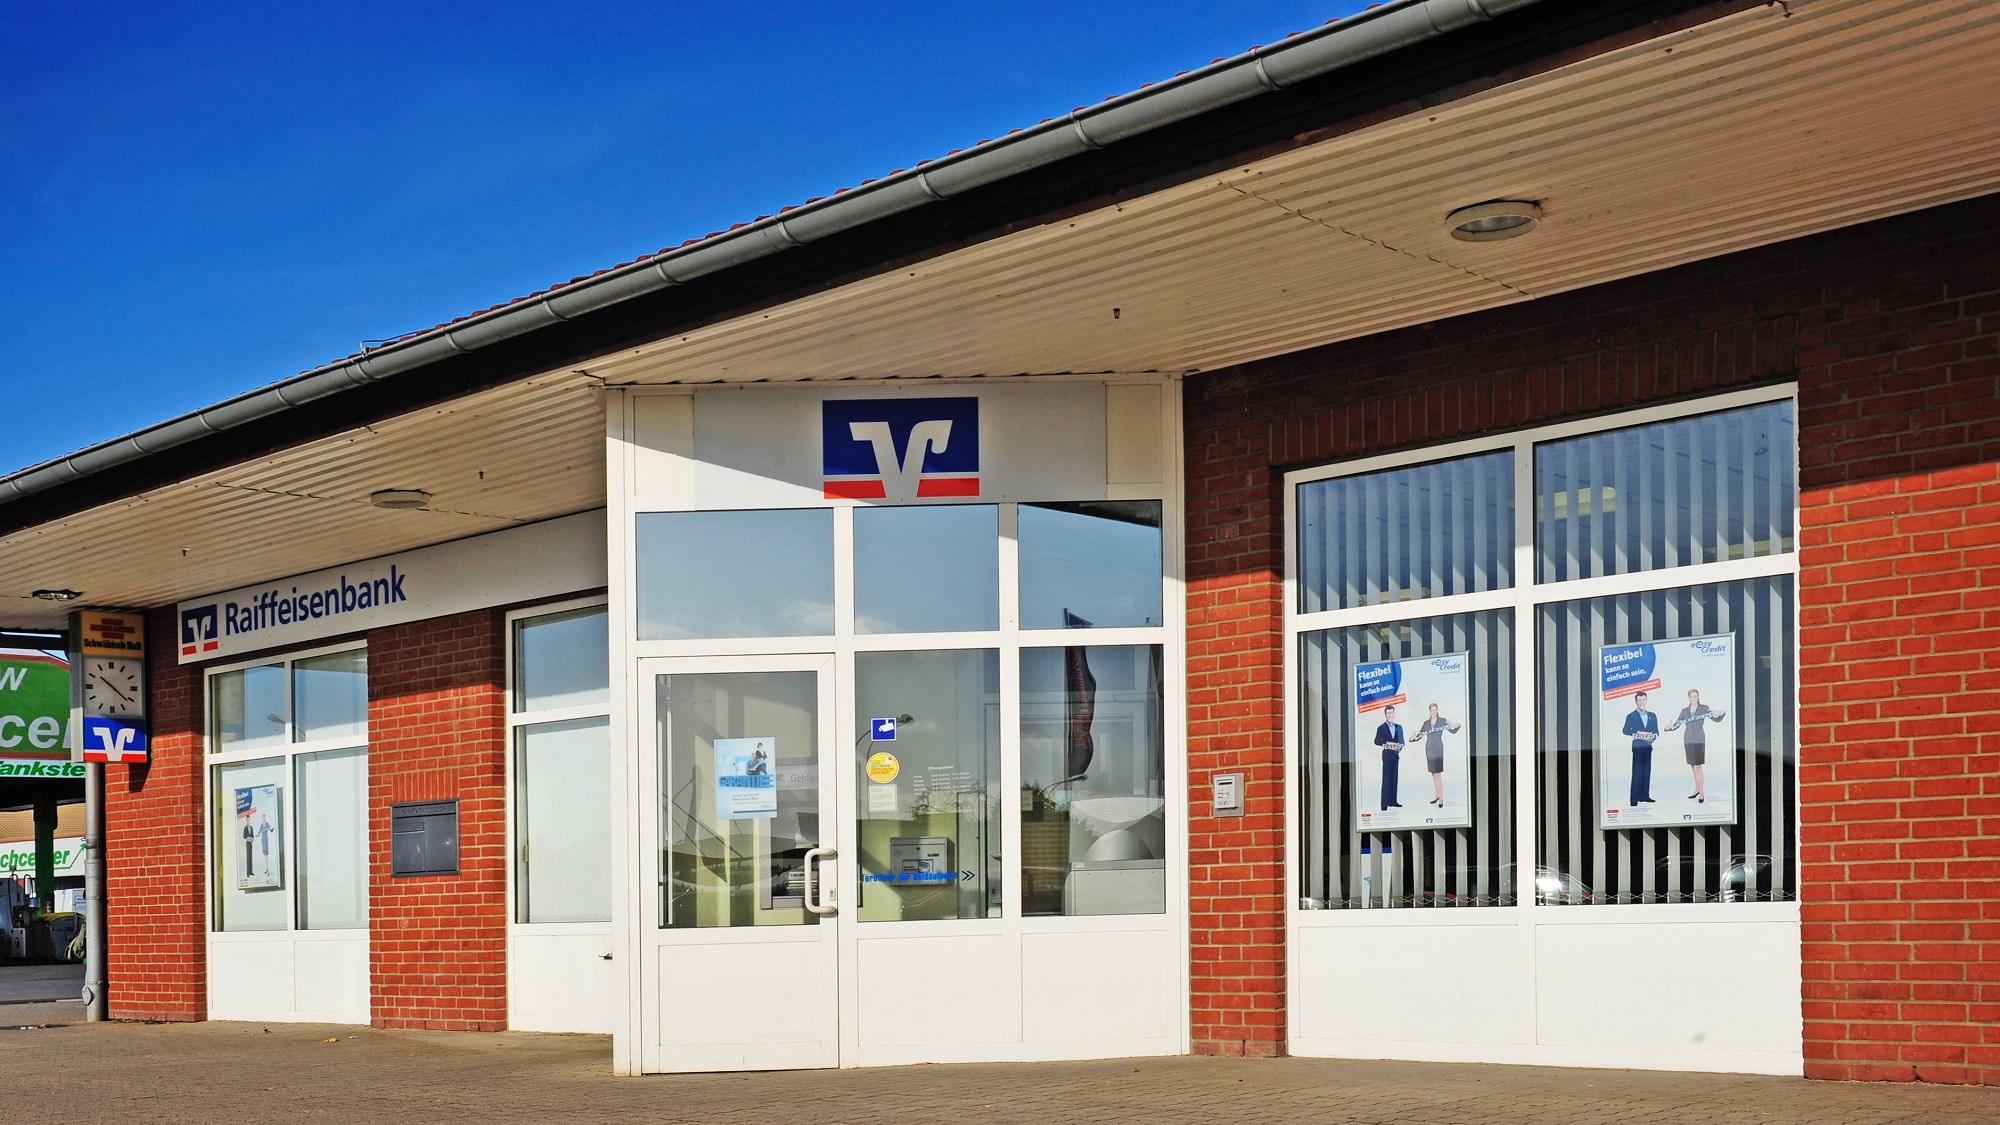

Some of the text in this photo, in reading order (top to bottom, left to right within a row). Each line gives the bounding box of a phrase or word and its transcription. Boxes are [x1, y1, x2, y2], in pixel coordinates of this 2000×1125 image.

[225, 564, 406, 636] Raiffeisenbank
[1604, 647, 1643, 666] Flexibel
[1358, 664, 1391, 682] Flexibel
[1605, 665, 1621, 674] kann
[1606, 667, 1647, 683] einfach sein.
[1359, 681, 1373, 690] kann
[1361, 686, 1381, 697] einfach
[719, 774, 774, 789] GARANTIE
